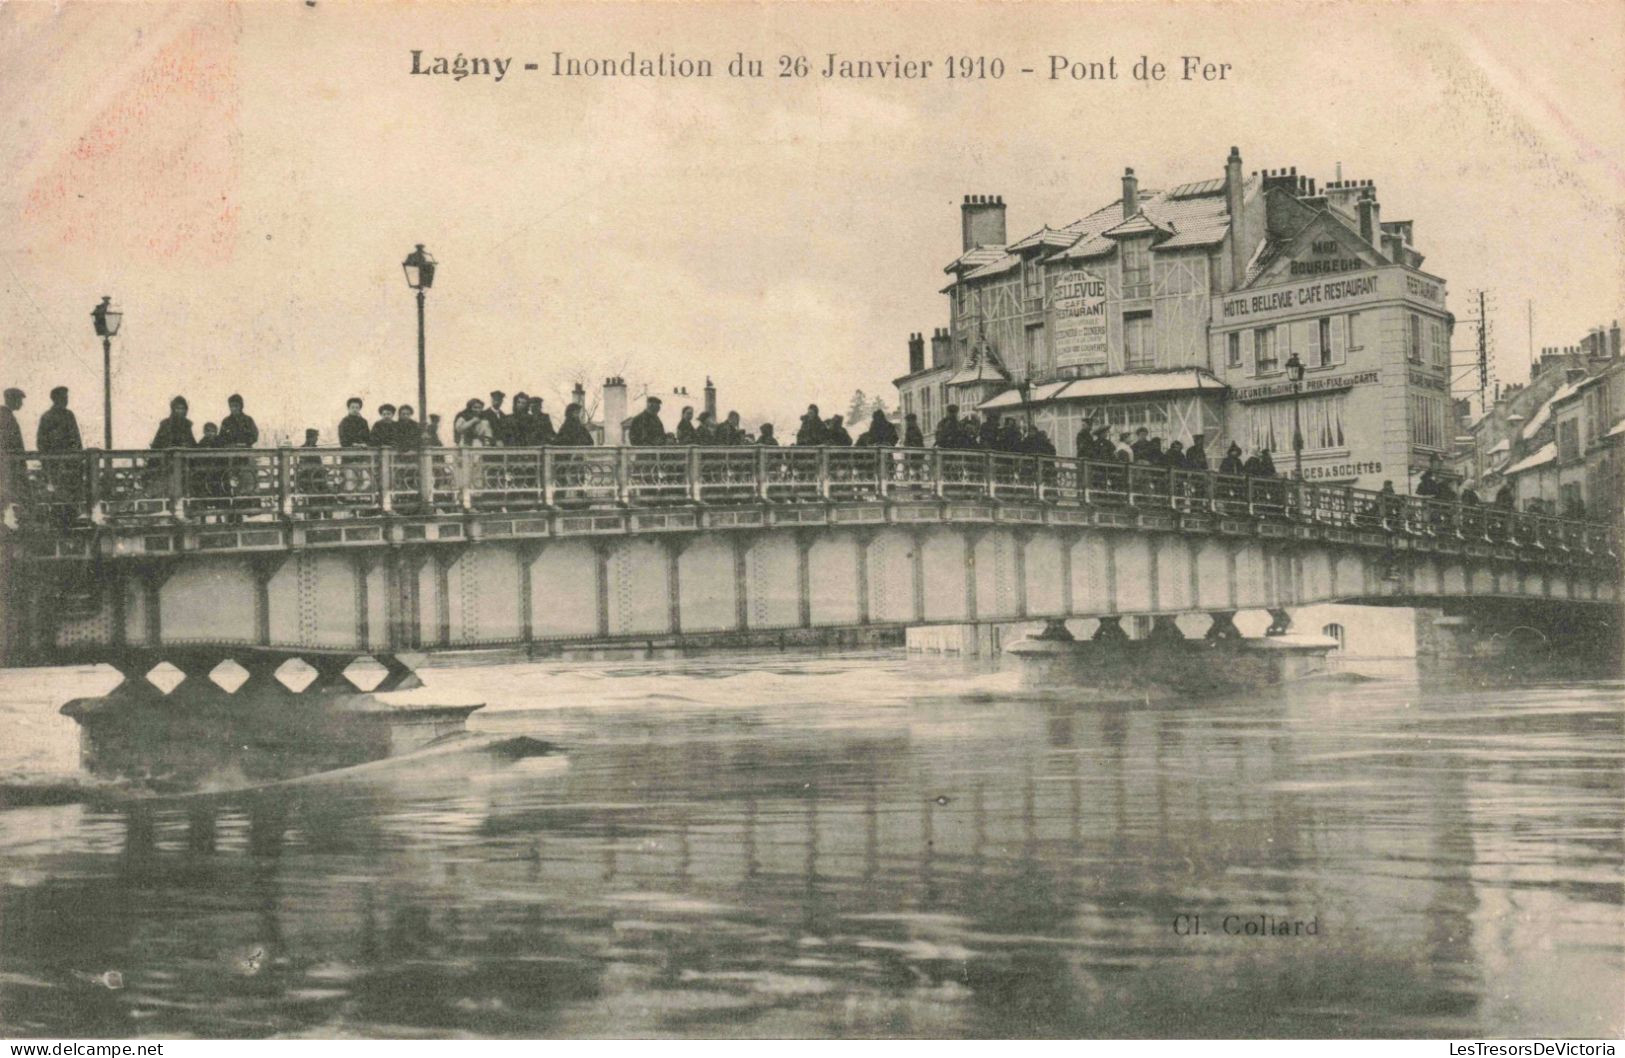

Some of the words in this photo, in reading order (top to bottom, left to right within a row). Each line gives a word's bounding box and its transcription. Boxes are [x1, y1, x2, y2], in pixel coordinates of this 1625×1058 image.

[1252, 290, 1293, 313] BELLEVUE
[1298, 282, 1322, 305] CAFÉ
[1324, 275, 1378, 301] RESTAURANT
[1332, 461, 1382, 478] SOCIÉTÉS
